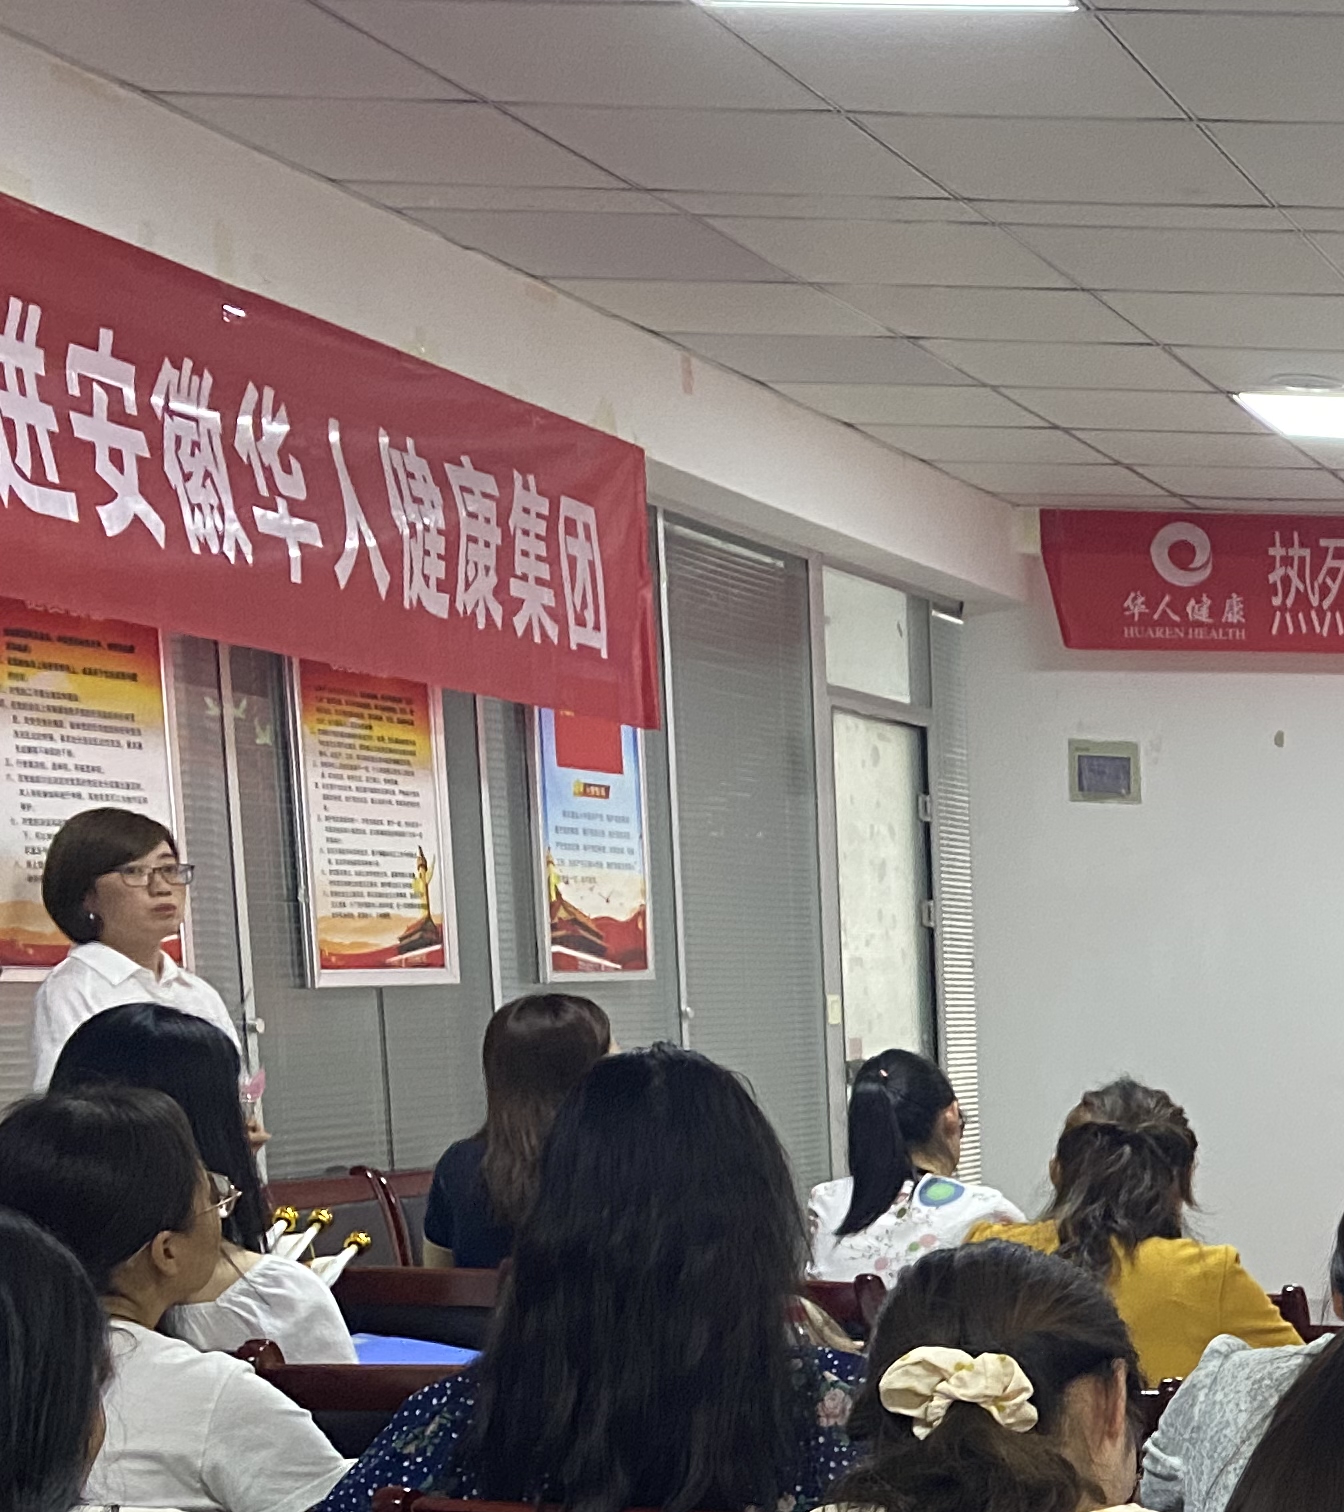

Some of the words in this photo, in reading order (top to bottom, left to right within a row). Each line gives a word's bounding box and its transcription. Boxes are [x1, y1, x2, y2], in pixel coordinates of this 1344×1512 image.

[1123, 591, 1246, 623] 华人健康
[1124, 626, 1184, 638] HUAREN
[1188, 627, 1246, 640] HEALTH
